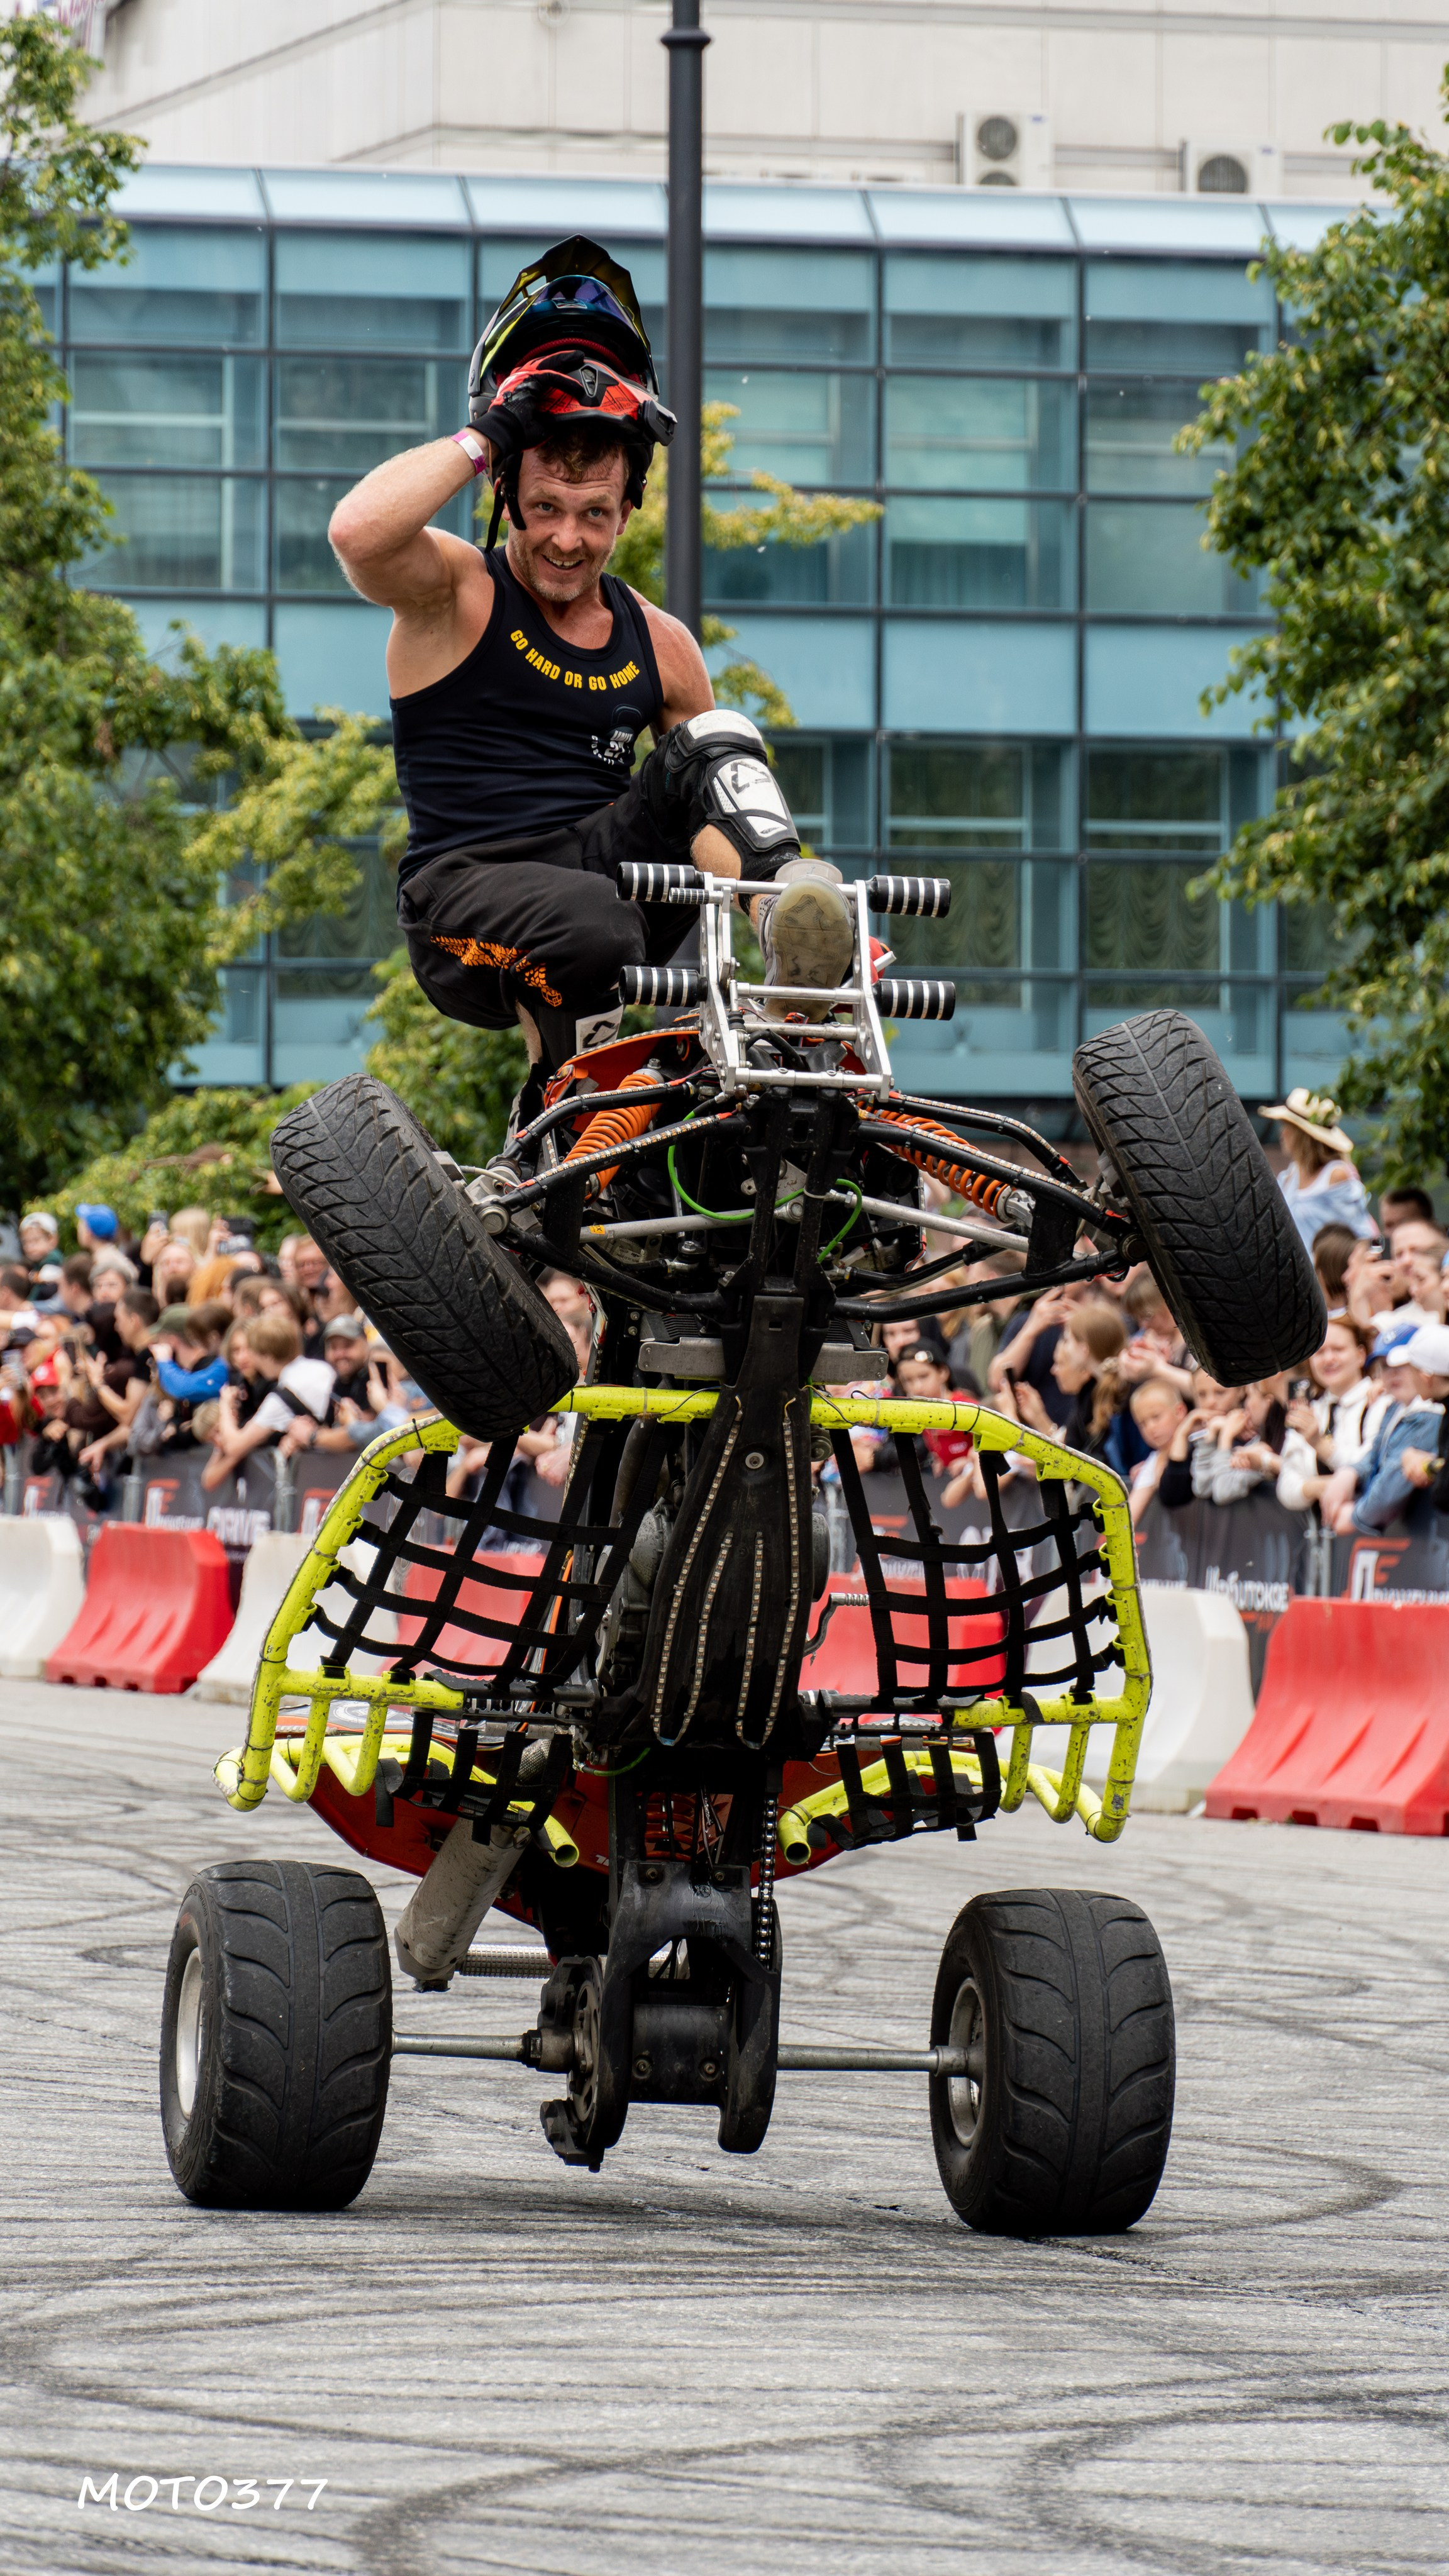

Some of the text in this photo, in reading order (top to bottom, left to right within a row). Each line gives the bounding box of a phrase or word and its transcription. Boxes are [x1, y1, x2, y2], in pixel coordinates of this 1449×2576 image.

[510, 630, 640, 691] GO HARD OR GO HOME
